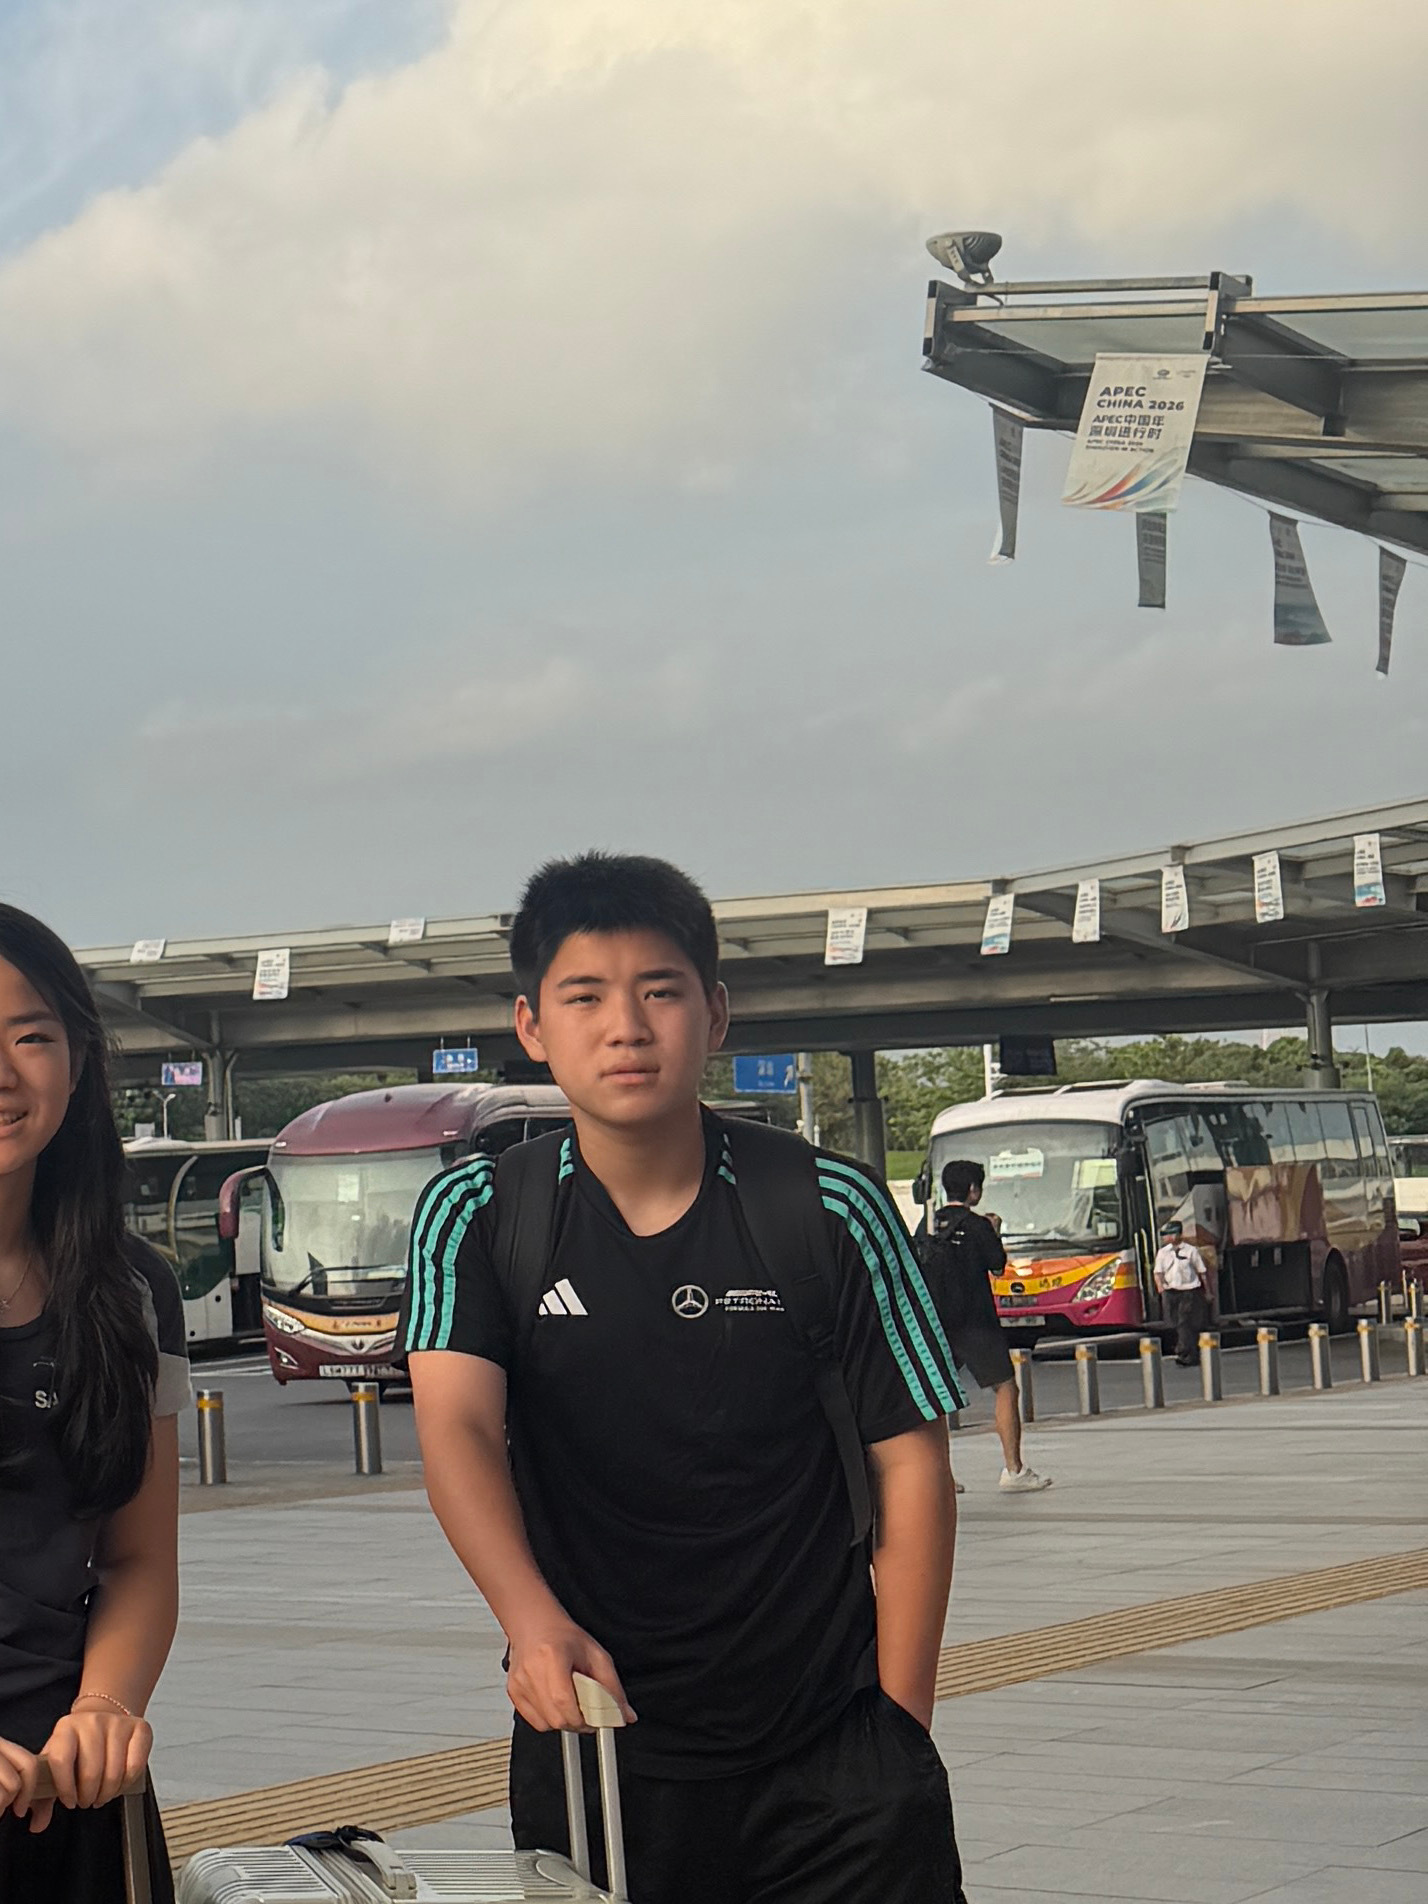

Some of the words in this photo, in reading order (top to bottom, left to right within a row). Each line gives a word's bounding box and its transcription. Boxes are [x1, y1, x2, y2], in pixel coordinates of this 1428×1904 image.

[1099, 386, 1147, 397] APEC
[1096, 399, 1144, 409] CHINA
[1148, 400, 1185, 411] 2026
